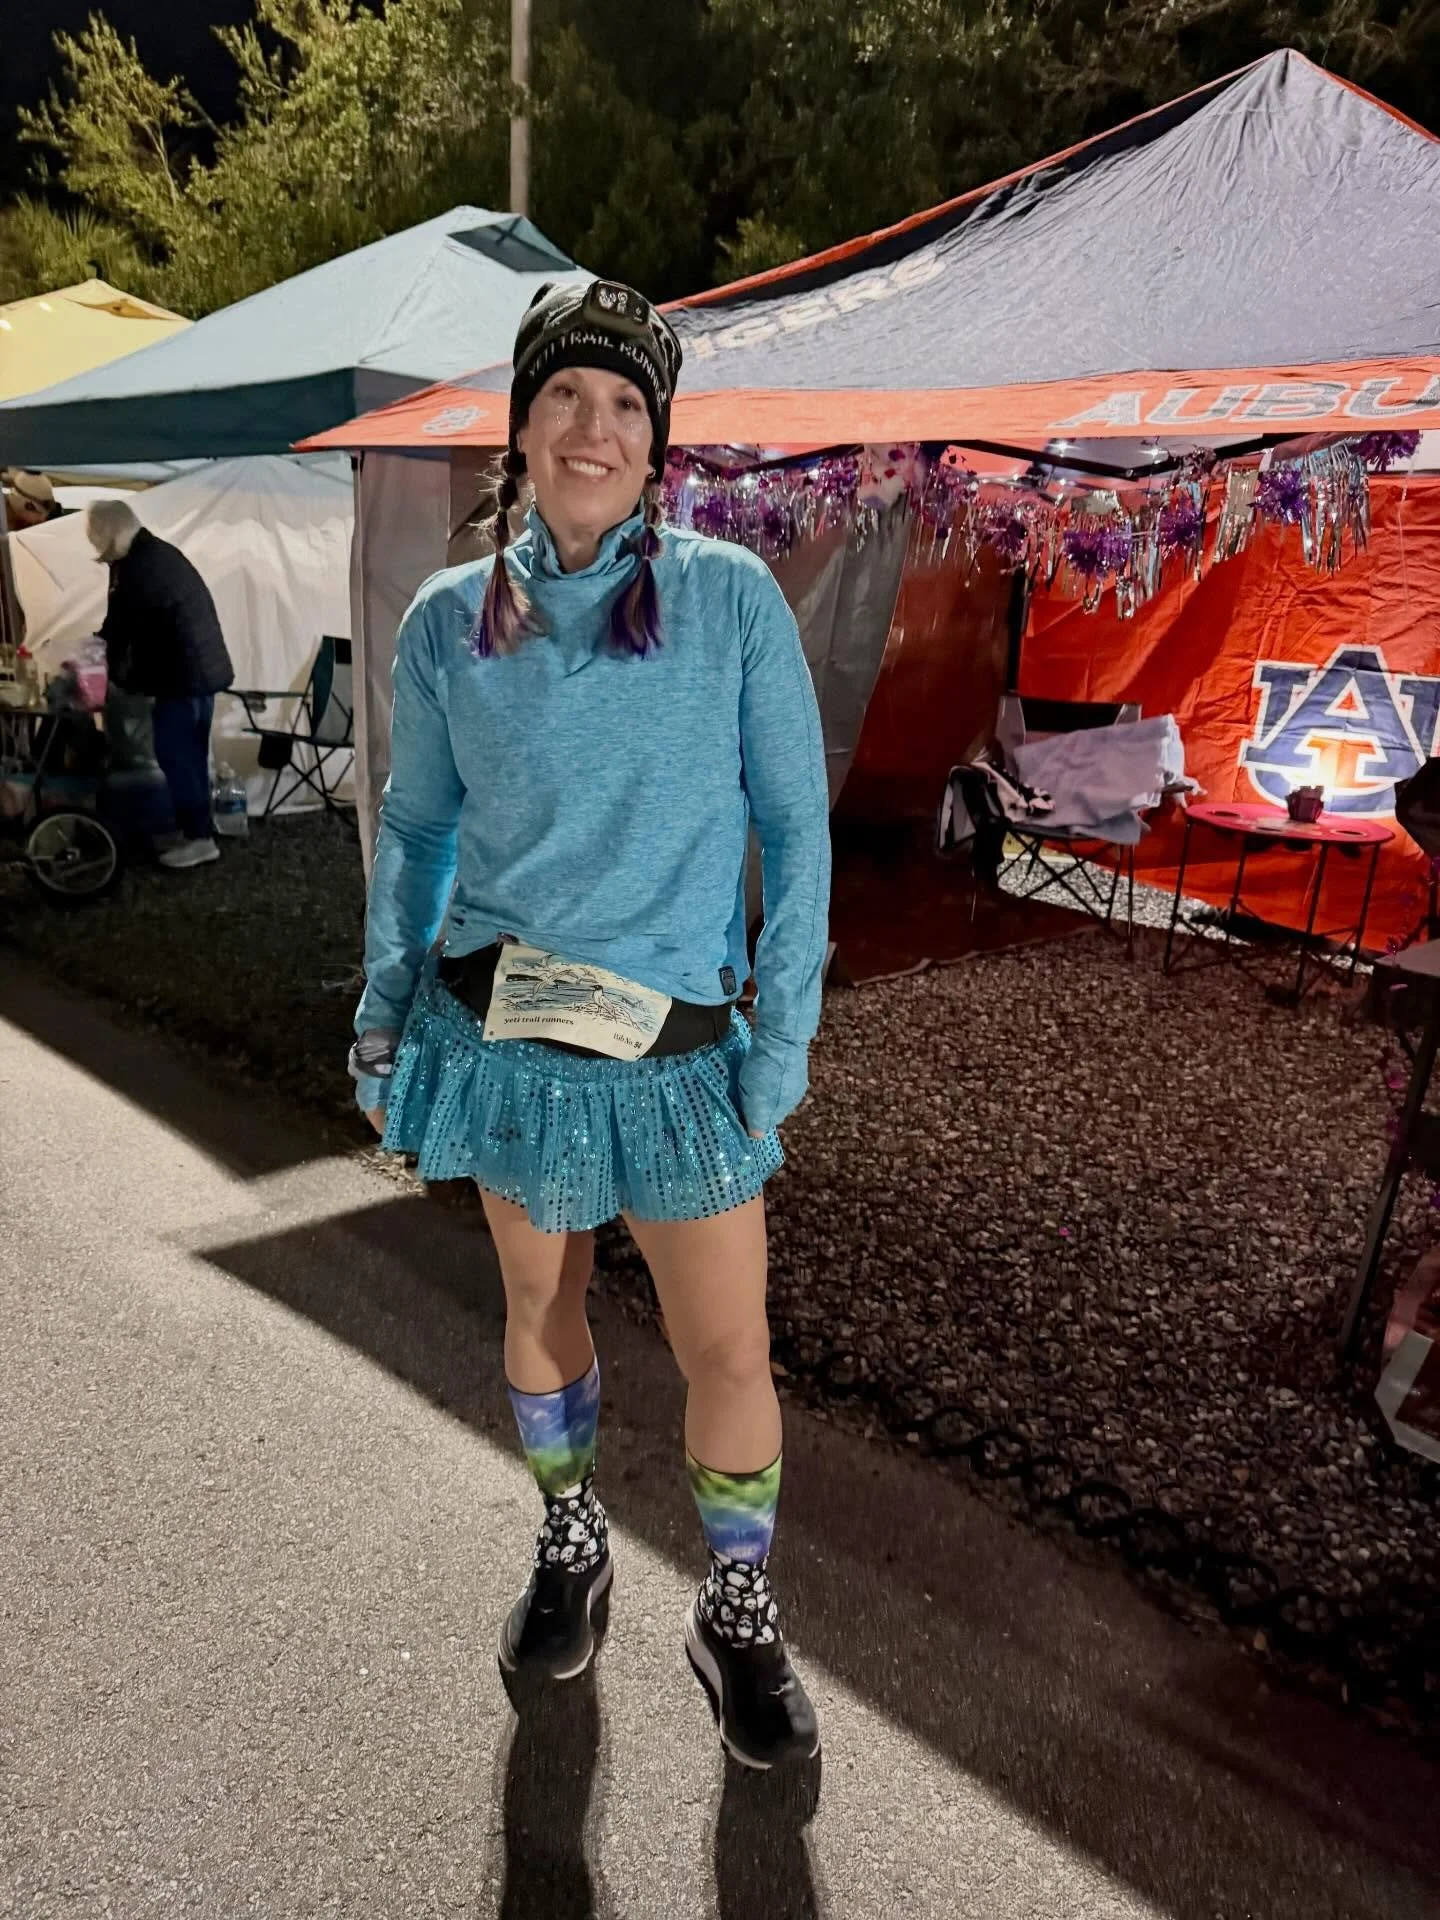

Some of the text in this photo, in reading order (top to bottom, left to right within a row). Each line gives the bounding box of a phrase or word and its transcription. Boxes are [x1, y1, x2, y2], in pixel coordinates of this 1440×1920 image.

[678, 253, 948, 358] IGERS
[561, 331, 614, 350] TRAIL
[503, 1015, 574, 1025] yeti trail runners
